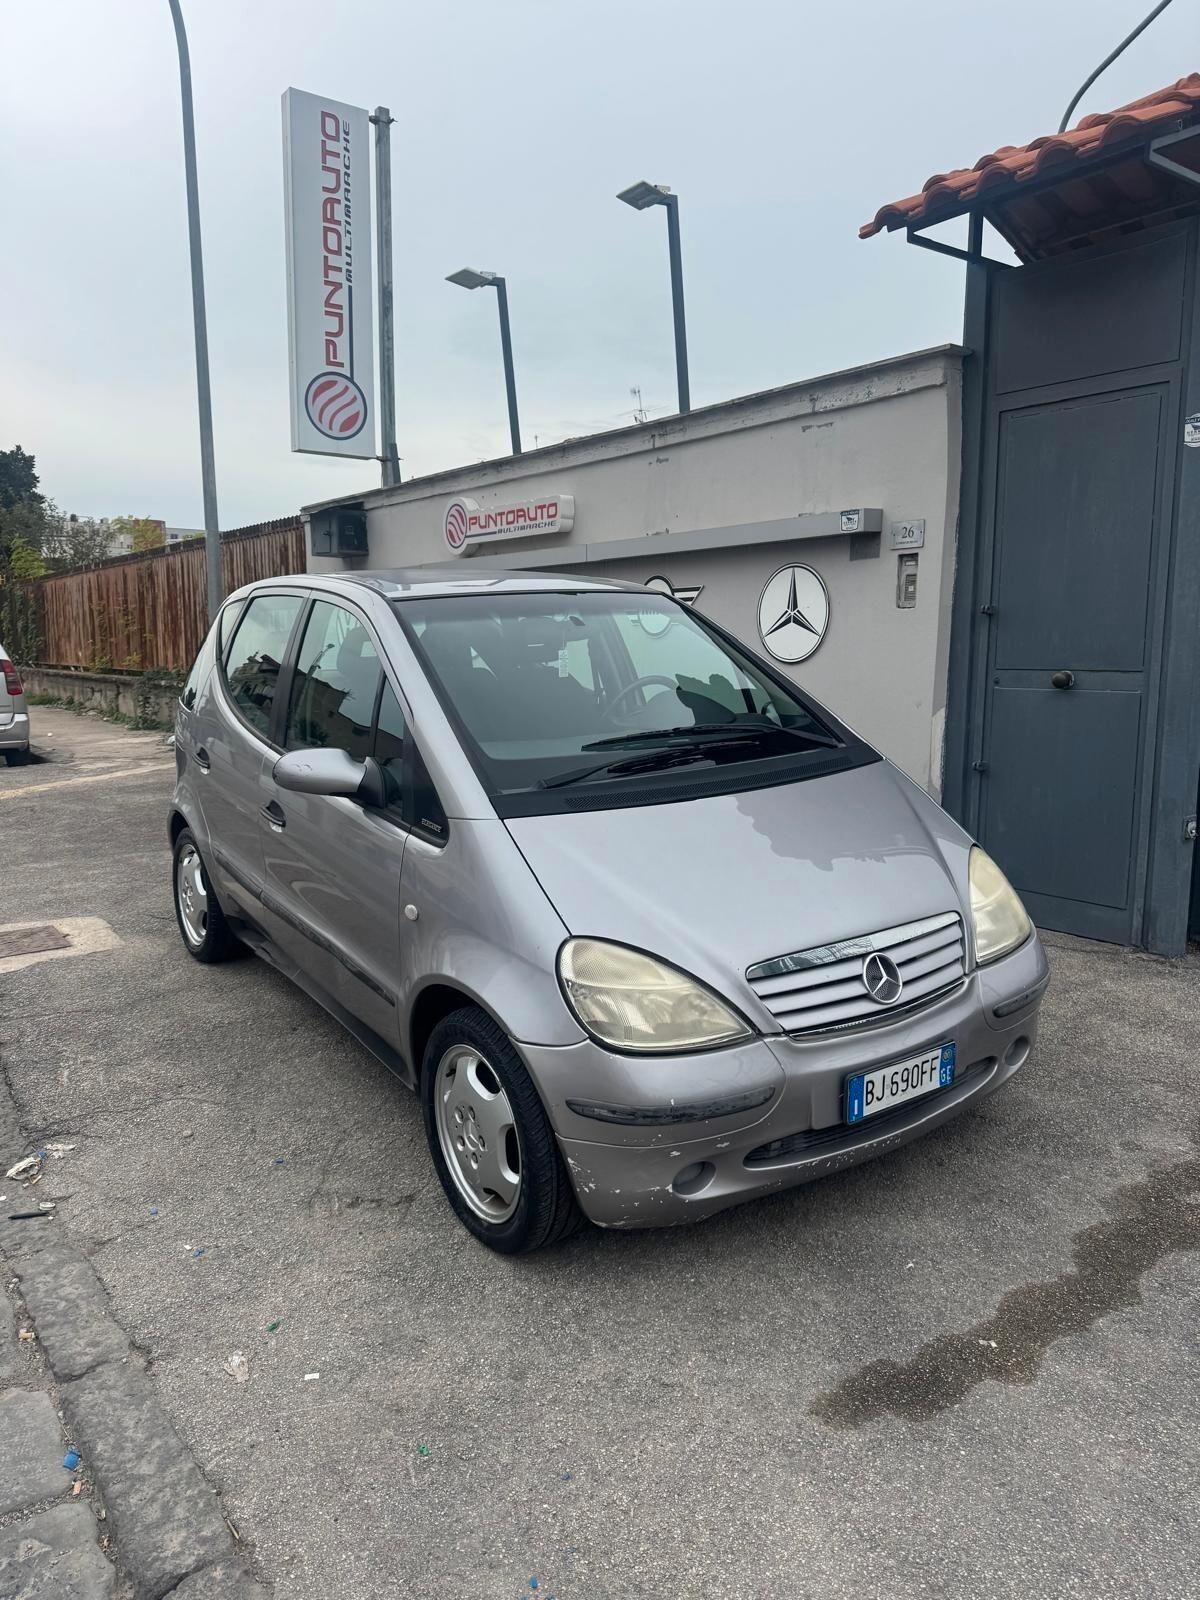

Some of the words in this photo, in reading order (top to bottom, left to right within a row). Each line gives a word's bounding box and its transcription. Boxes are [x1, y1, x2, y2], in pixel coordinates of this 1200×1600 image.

[343, 119, 353, 284] MULTIMARCHE
[321, 110, 345, 368] PUNTOAUTO
[468, 502, 558, 531] PUNTOAUTO
[496, 520, 558, 534] MULTIMARCHE
[901, 526, 914, 538] 26
